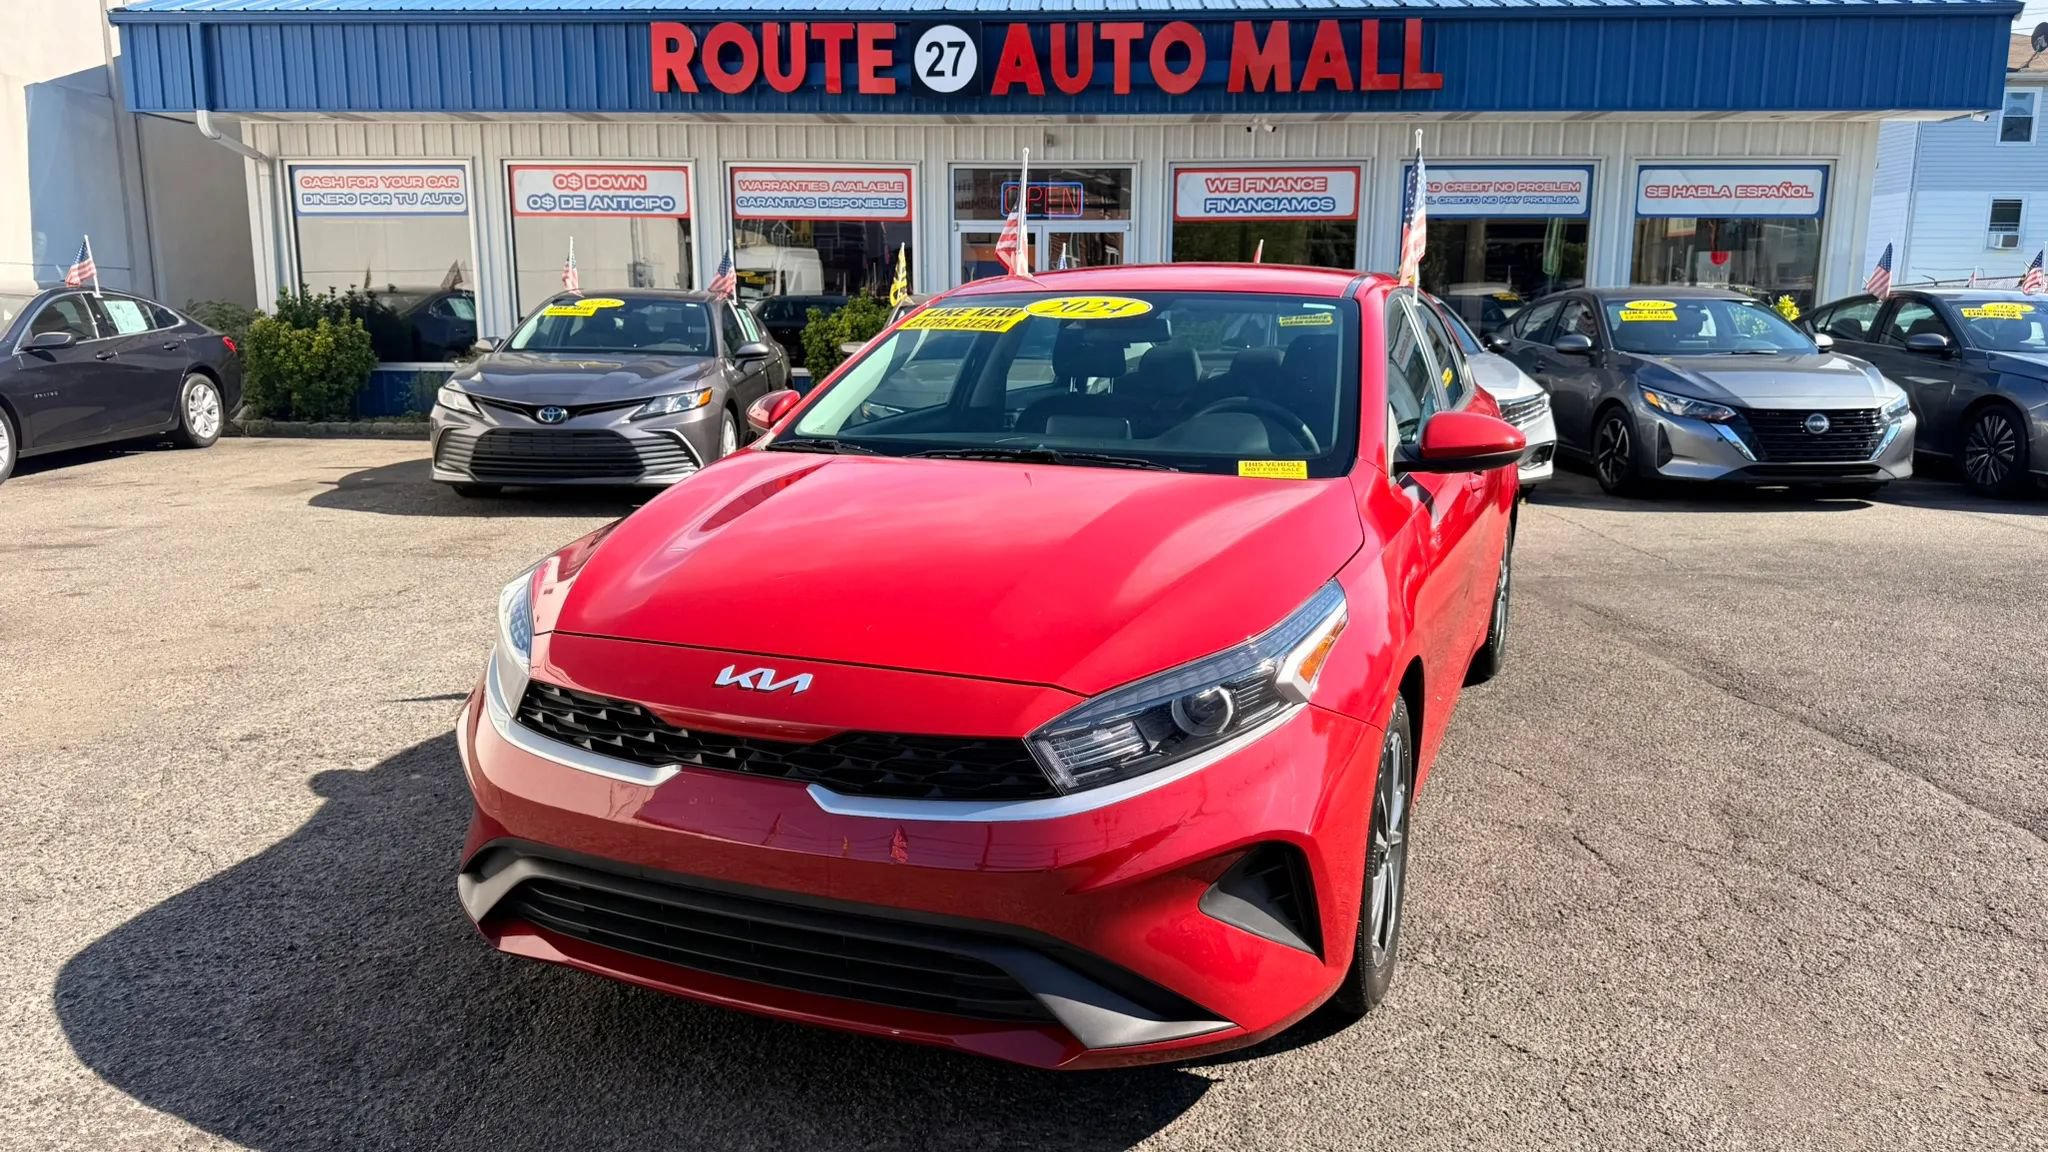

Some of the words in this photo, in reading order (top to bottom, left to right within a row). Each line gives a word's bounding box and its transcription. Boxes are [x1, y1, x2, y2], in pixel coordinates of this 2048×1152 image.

[650, 21, 896, 95] ROUTE
[925, 41, 967, 78] 27
[990, 21, 1206, 96] AUTO
[1227, 18, 1443, 94] MALL
[300, 176, 345, 189] CASH
[347, 176, 378, 189] FOR
[381, 176, 424, 189] YOUR
[426, 176, 459, 189] CAR
[585, 174, 647, 190] DOWN
[738, 179, 829, 193] WARRANTIES
[832, 180, 904, 193] AVAILABLE
[1205, 177, 1241, 193] WE
[1243, 177, 1327, 193] FINANCE
[1426, 182, 1442, 192] AD
[1444, 182, 1493, 193] CREDIT
[1494, 182, 1514, 193] NO
[1516, 182, 1581, 193] PROBLEM
[1645, 185, 1669, 198] SE
[1671, 185, 1732, 199] HABLA
[1735, 181, 1814, 199] ESPAÑOL
[302, 193, 358, 206] DINERO
[359, 193, 391, 206] POR
[394, 193, 417, 206] TU
[420, 193, 464, 206] AUTO
[559, 195, 586, 210] DE
[588, 195, 675, 212] ANTICIPO
[736, 196, 816, 209] GARANTIAS
[818, 197, 906, 210] DISPONIBLES
[1004, 186, 1082, 214] OPEN
[1204, 197, 1335, 213] FINANCIAMOS
[1426, 195, 1436, 205] AL
[1437, 195, 1481, 205] CREDITO
[1482, 195, 1498, 205] NO
[1499, 195, 1521, 205] HAY
[1523, 196, 1580, 205] PROBLEMA
[922, 308, 967, 317] LIKE
[977, 308, 1023, 318] NEW
[1042, 300, 1135, 313] 2024
[907, 318, 952, 327] EXTRA
[954, 319, 1007, 329] CLEAN
[714, 664, 814, 694] KIA
